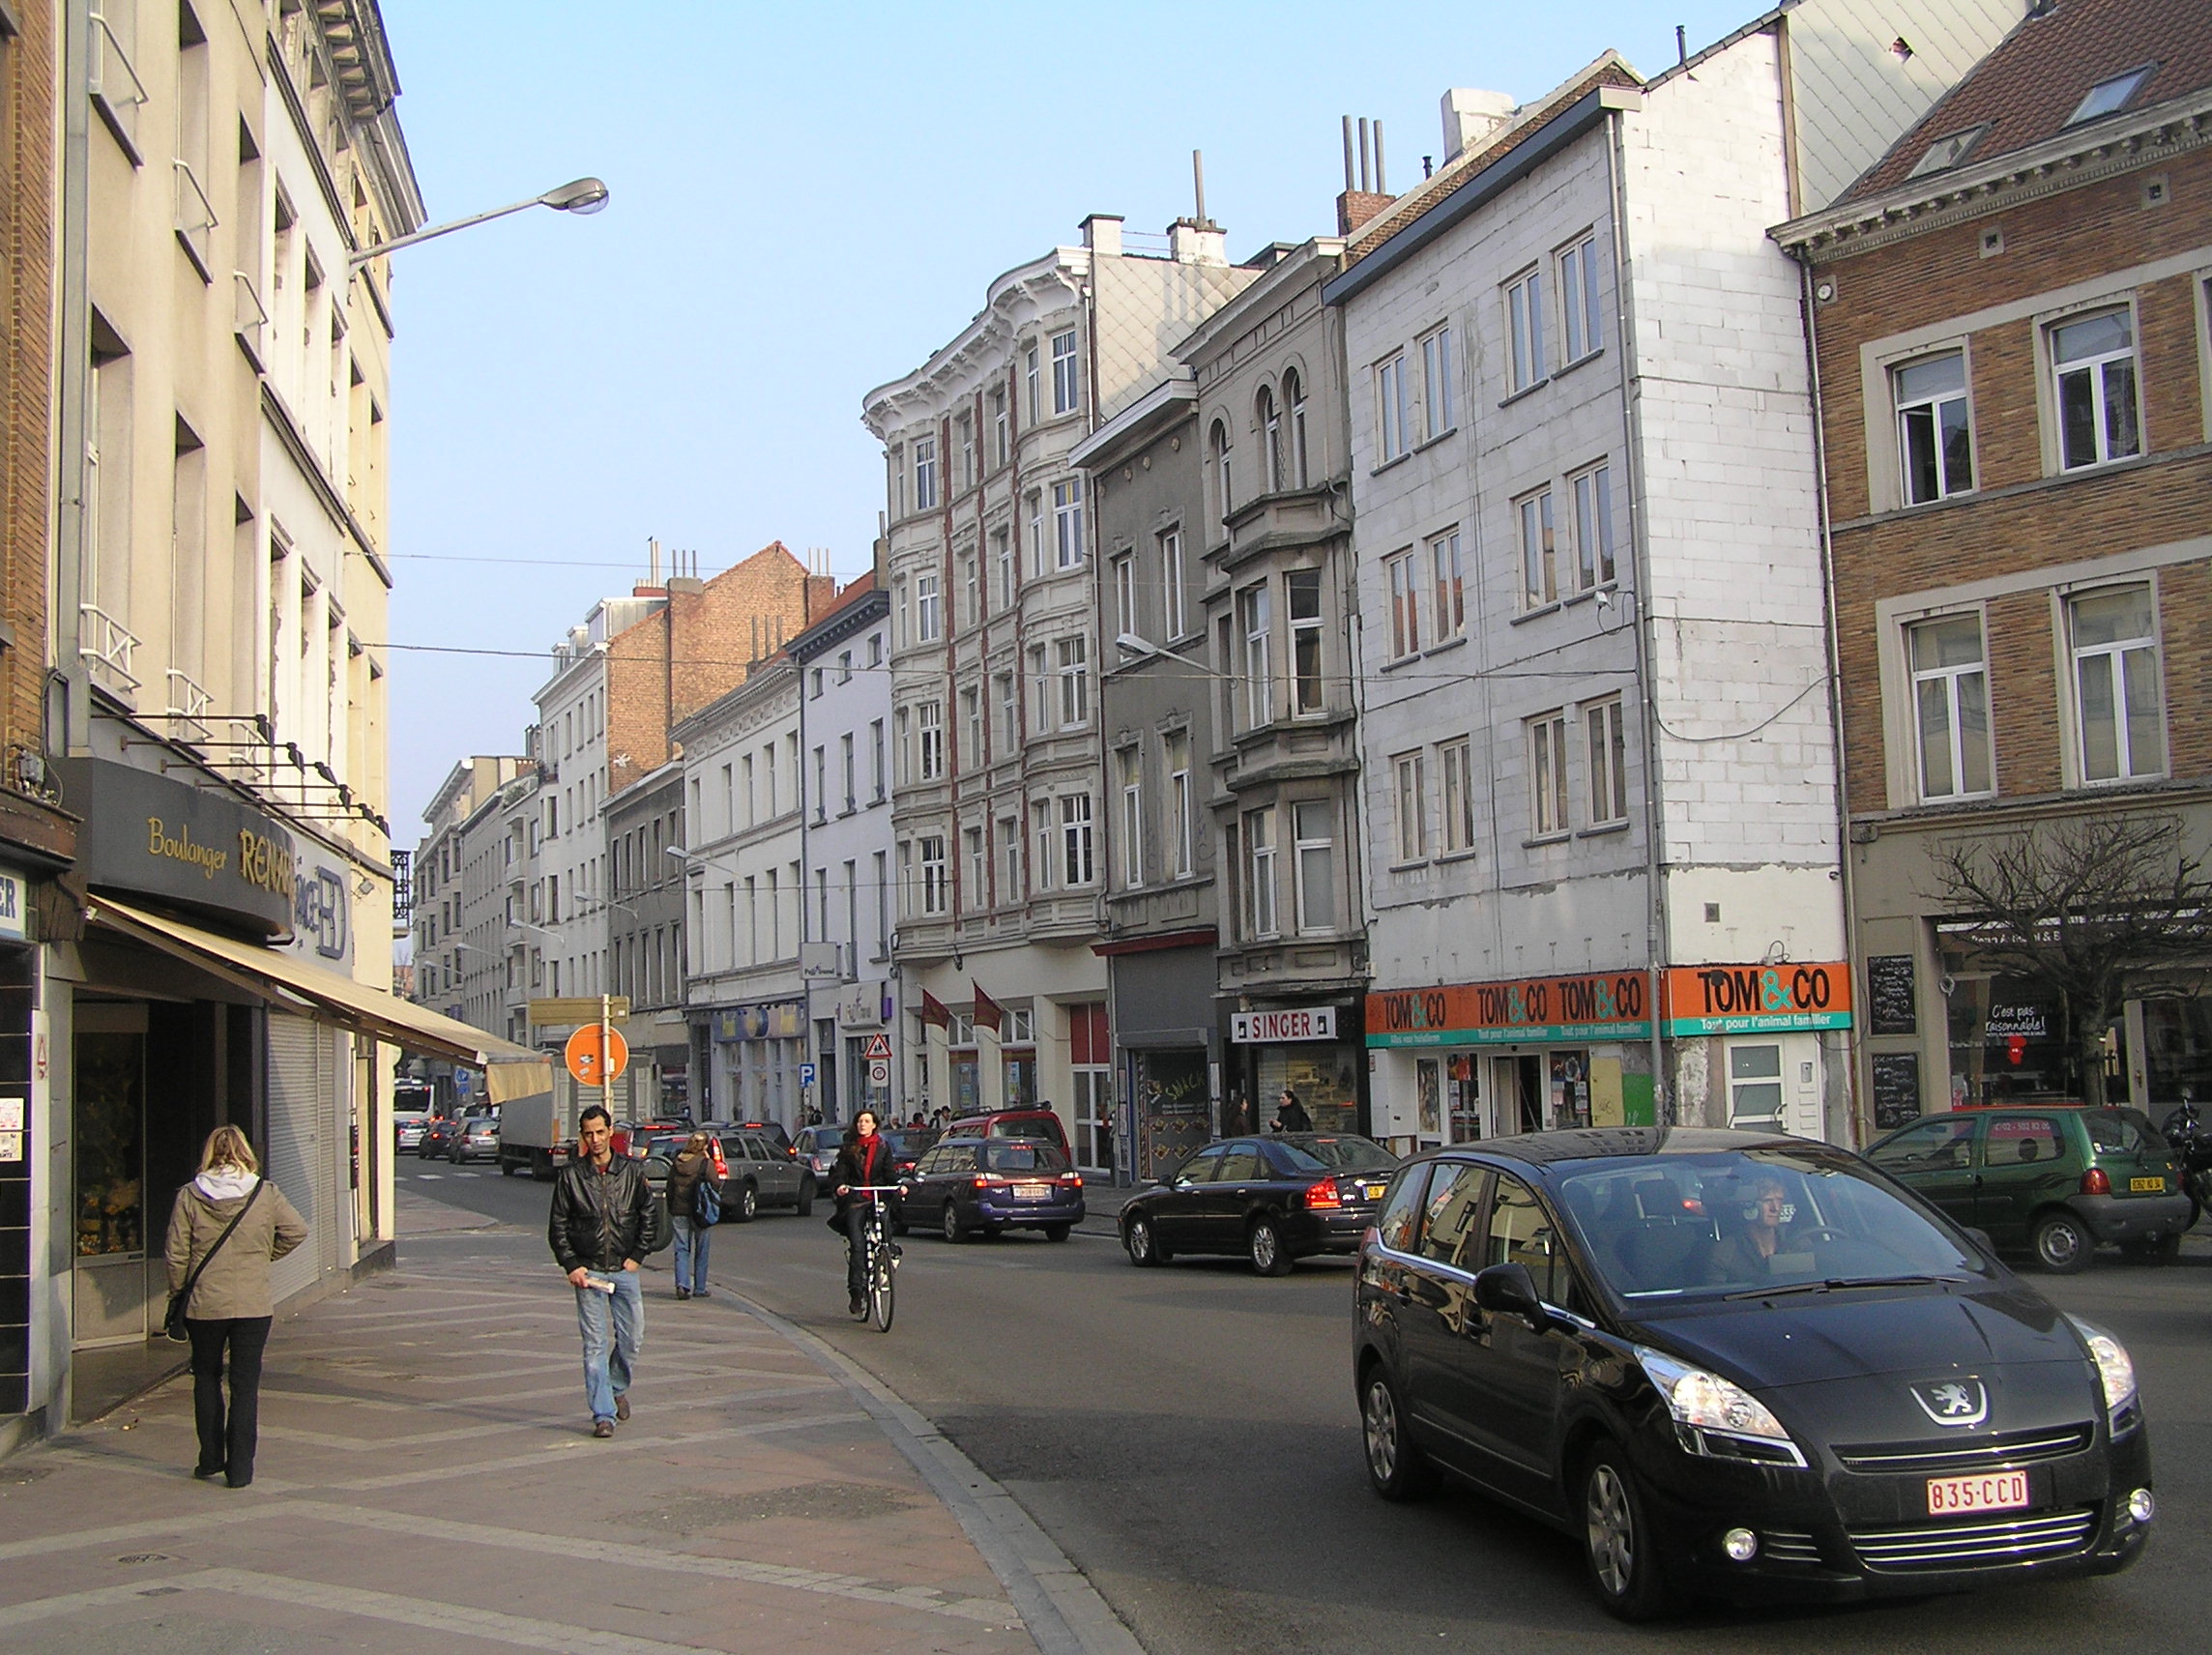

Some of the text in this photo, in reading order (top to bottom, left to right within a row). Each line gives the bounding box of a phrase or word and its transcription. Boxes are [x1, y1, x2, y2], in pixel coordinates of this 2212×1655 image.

[147, 816, 227, 880] Boulanger
[1476, 984, 1548, 1025] TOM&CO
[1557, 976, 1642, 1022] TOM&CO
[1698, 969, 1831, 1013] TOM&CO
[1252, 1012, 1311, 1039] SINGER
[1383, 993, 1446, 1030] TOM&CO
[1726, 1019, 1749, 1031] pour
[1751, 1015, 1790, 1028] l'animal
[1793, 1014, 1831, 1027] familier
[1992, 1004, 2035, 1022] C'est pas
[801, 1065, 813, 1085] P
